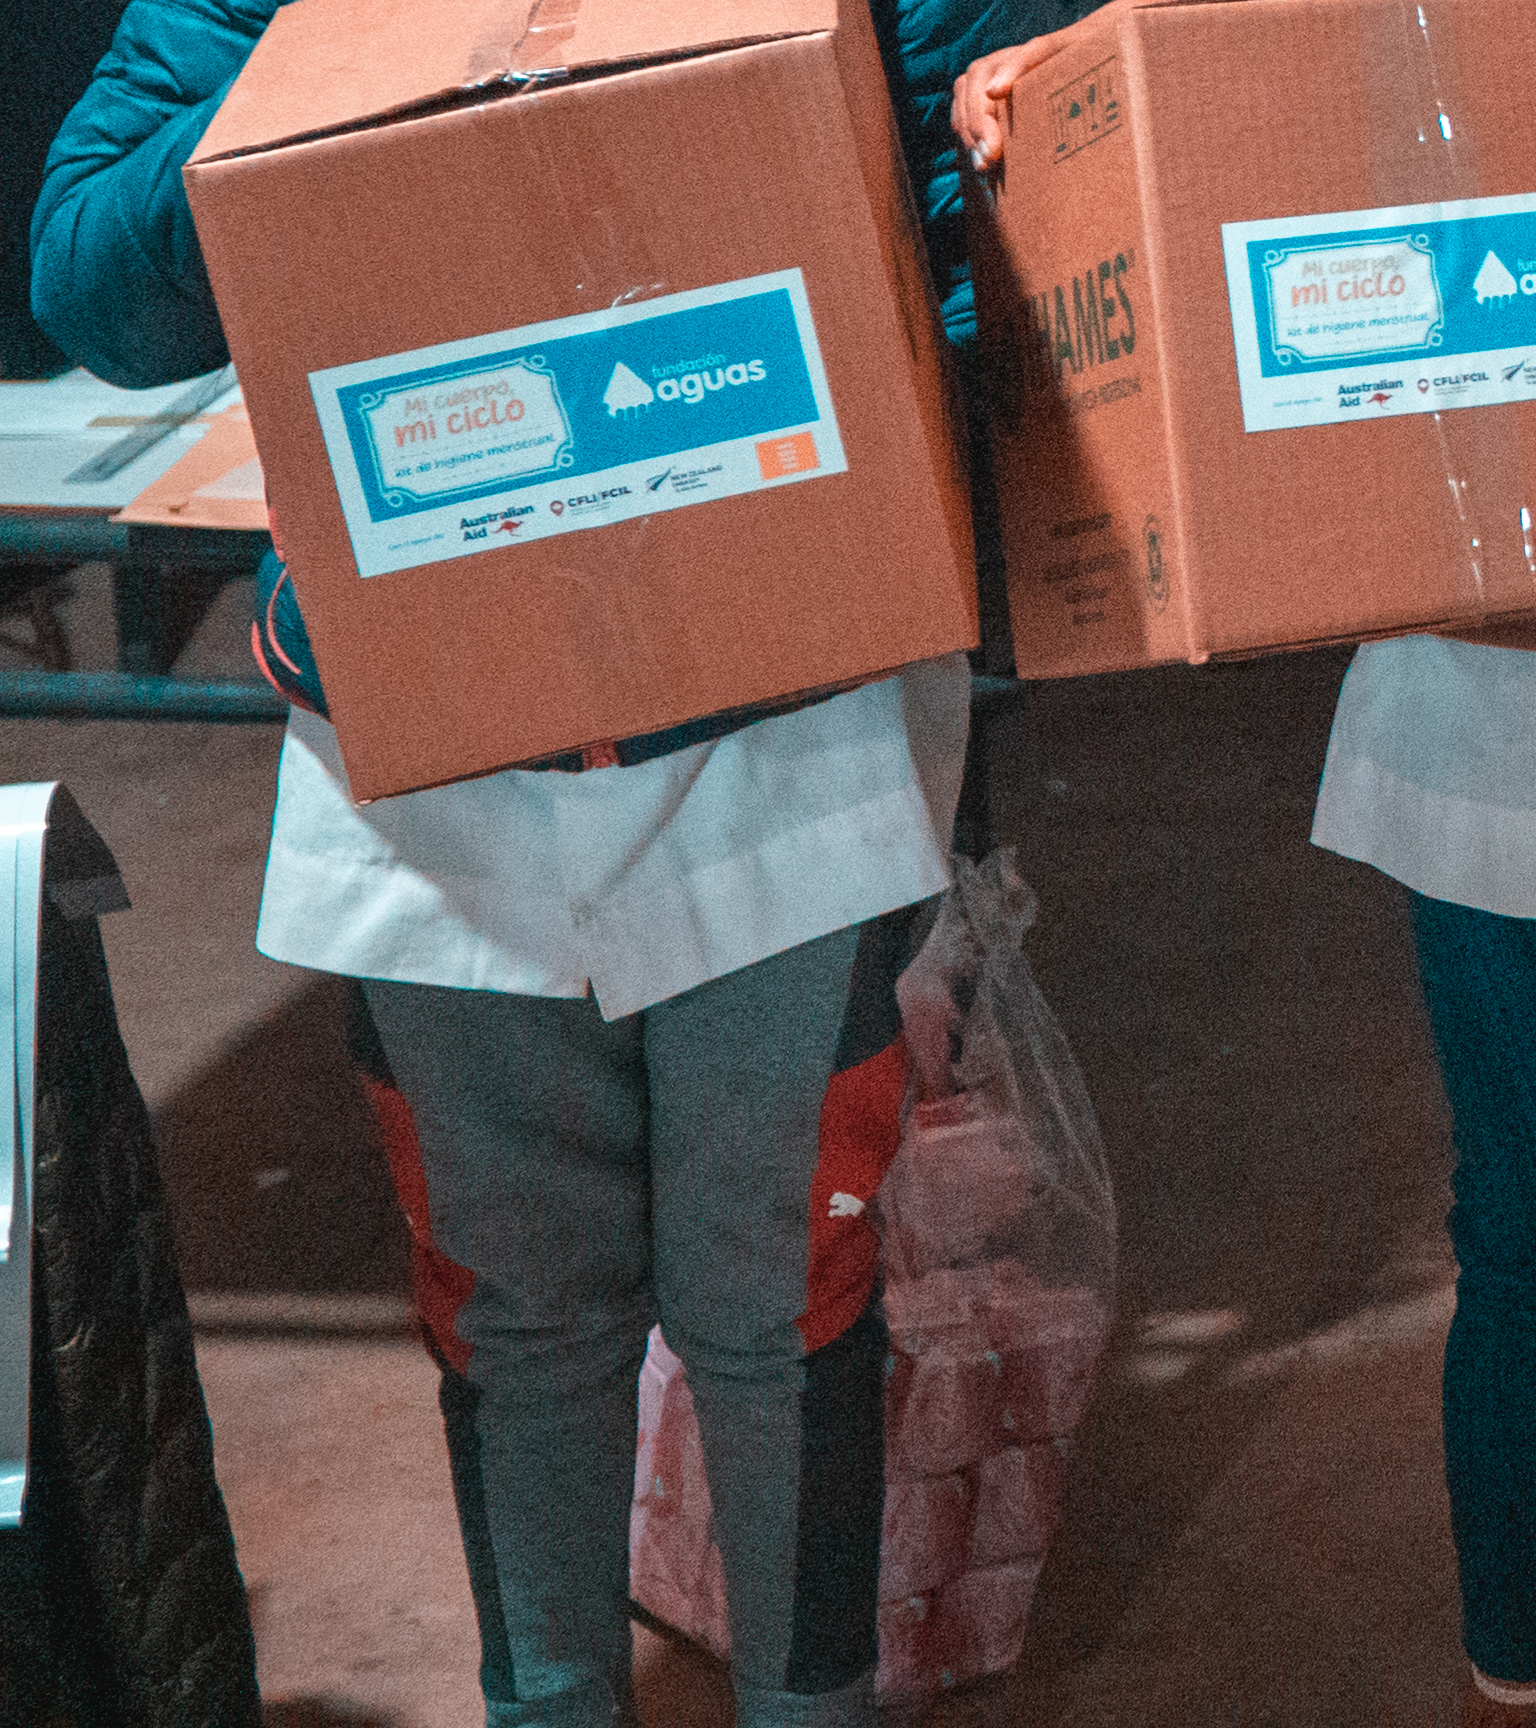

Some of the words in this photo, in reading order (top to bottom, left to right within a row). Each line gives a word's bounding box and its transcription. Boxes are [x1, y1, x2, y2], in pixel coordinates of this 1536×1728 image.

[1291, 278, 1328, 308] mi
[1337, 273, 1406, 302] ciclo
[656, 359, 767, 404] aguas
[1338, 379, 1404, 396] Australian
[1339, 396, 1361, 409] Aid
[394, 414, 436, 448] mi
[446, 399, 525, 435] ciclo
[460, 504, 535, 530] Australian
[462, 528, 488, 542] Aid
